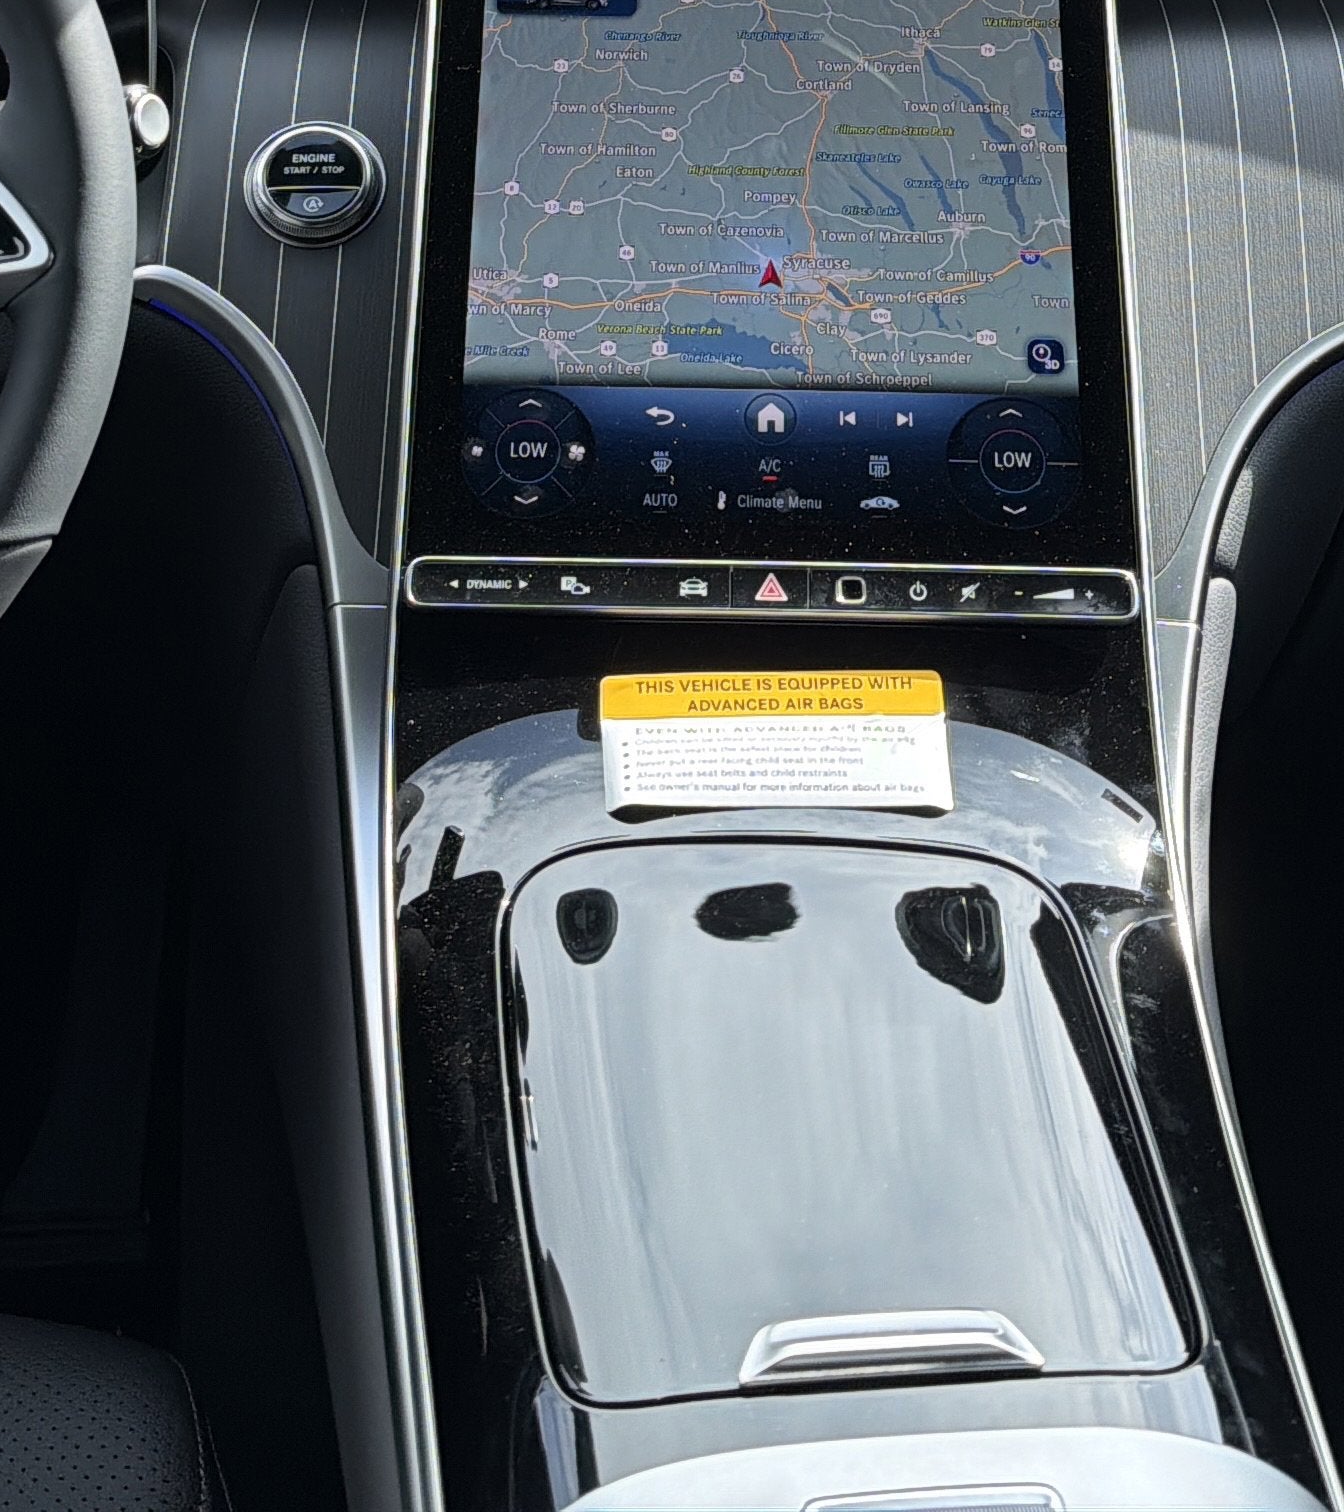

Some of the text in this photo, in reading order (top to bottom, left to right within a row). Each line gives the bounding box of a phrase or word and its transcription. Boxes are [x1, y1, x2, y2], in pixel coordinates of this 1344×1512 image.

[982, 17, 1048, 28] Watkins Glen
[605, 31, 681, 42] Chenango River
[901, 27, 941, 39] Ithaca
[595, 49, 648, 61] Norwich
[817, 60, 920, 76] Town of Dryden
[796, 79, 852, 90] Cortland
[552, 101, 676, 115] Town of Sherburne
[903, 101, 1010, 116] Town of Lansing
[877, 125, 900, 136] Glen
[903, 126, 928, 136] State
[932, 126, 955, 137] Park
[540, 143, 656, 156] Town of Hamilton
[981, 140, 1035, 153] Town of
[292, 153, 336, 163] ENGINE
[877, 153, 902, 163] Lake
[283, 166, 345, 174] START STOP
[616, 166, 653, 178] Eaton
[688, 165, 804, 178] Highland County Forest
[904, 179, 969, 190] Owasco Lake
[1018, 176, 1042, 185] Lake
[744, 191, 797, 205] Pompey
[876, 206, 901, 217] Lake
[937, 210, 986, 224] Auburn
[659, 223, 784, 238] Town of Cazenovia
[820, 230, 944, 244] Town of Marcellus
[650, 261, 760, 274] Town of Manlius
[782, 256, 851, 270] Syracuse
[473, 269, 507, 280] Utica
[878, 269, 994, 283] Town of Camillus
[712, 293, 811, 306] Town of Salina
[857, 290, 967, 305] Town of Geddes
[1033, 295, 1070, 308] Town
[491, 303, 507, 315] of
[510, 304, 552, 317] Marcy
[614, 300, 662, 312] Oneida
[538, 328, 577, 340] Rome
[596, 324, 724, 335] Verona Beach State Park
[816, 323, 847, 338] Clay
[499, 346, 529, 357] Creek
[770, 342, 814, 355] Cicero
[716, 354, 743, 364] Lake
[851, 350, 972, 366] Town of Lysander
[558, 363, 642, 375] Town of Lee
[1044, 360, 1060, 370] 3D
[796, 373, 933, 387] Town of Schroeppel
[509, 442, 549, 459] LOW
[758, 459, 782, 473] A/C
[993, 451, 1032, 468] LOW
[642, 493, 678, 507] AUTO
[737, 494, 823, 510] Climate Menu
[466, 579, 512, 590] DYNAMIC
[635, 676, 912, 694] THIS VEHICLE IS EQUIPPED WITH
[687, 697, 864, 713] ADVANCED AIR BAGS
[797, 768, 848, 778] restraints
[702, 783, 881, 792] manual information about
